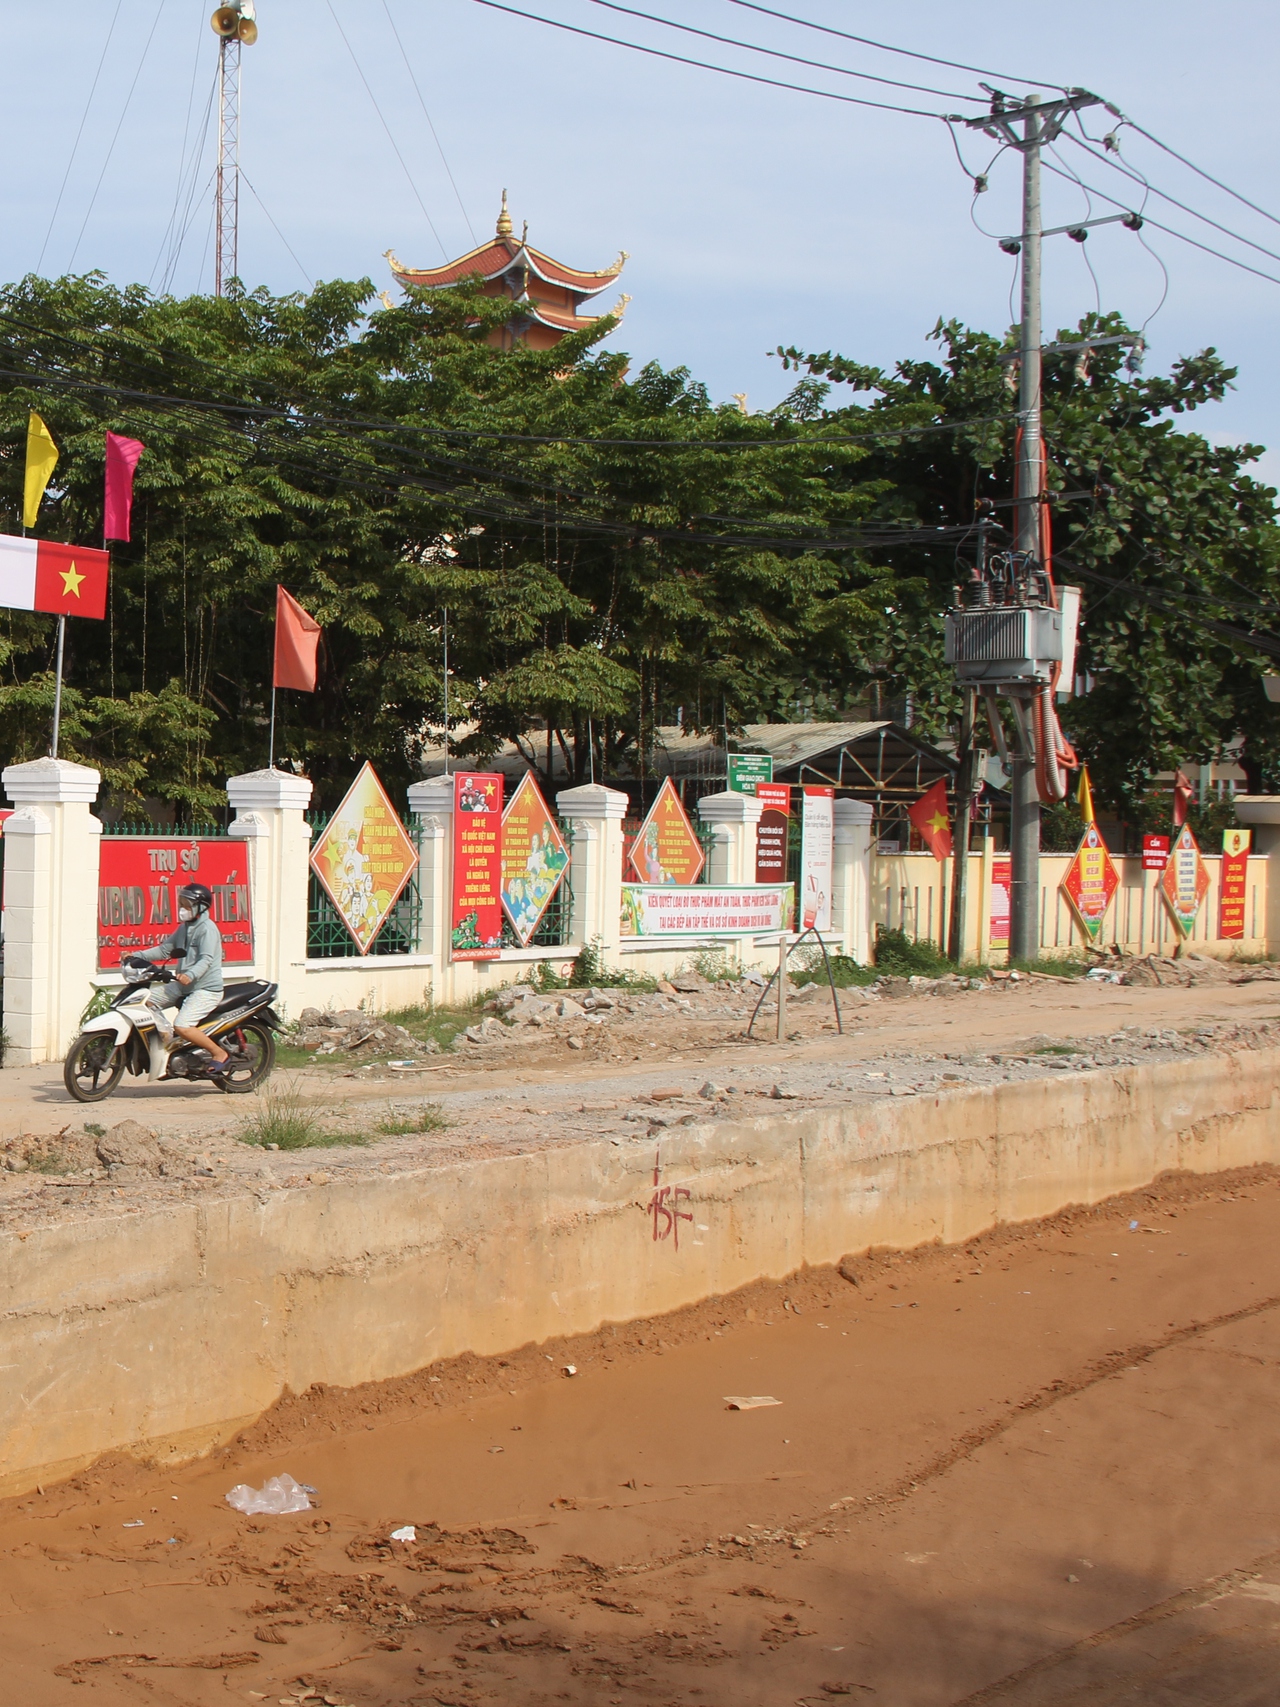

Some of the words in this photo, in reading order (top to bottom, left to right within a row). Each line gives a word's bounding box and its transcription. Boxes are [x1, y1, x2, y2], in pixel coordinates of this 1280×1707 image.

[486, 832, 496, 840] NAM
[148, 849, 177, 877] TRỤ
[180, 841, 200, 872] SỞ
[98, 885, 145, 927] UBND
[149, 875, 171, 925] XÃ
[211, 870, 249, 923] TIẾN
[117, 932, 141, 947] Quốc
[142, 934, 154, 948] Lộ
